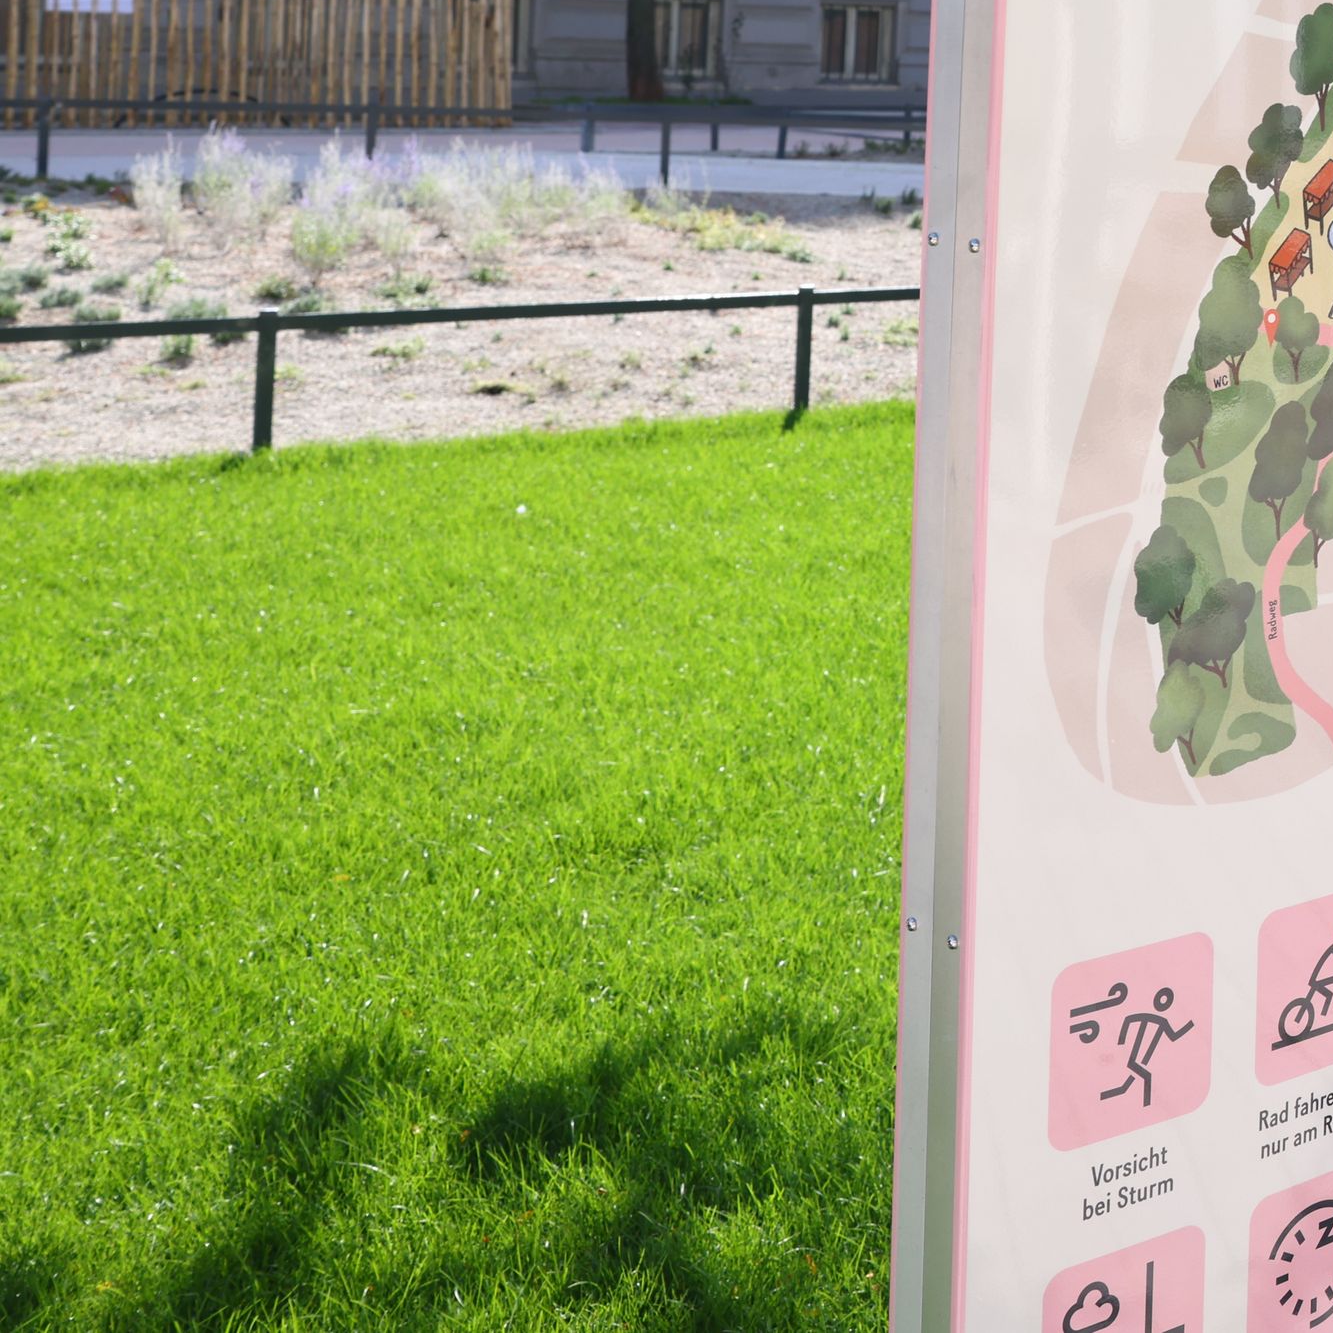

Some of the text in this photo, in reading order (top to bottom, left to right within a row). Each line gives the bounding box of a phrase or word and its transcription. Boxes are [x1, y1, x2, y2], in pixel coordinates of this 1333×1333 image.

[1213, 375, 1229, 389] WC
[1267, 600, 1278, 640] Radweg
[1258, 1101, 1289, 1132] Rad
[1260, 1136, 1289, 1159] nur
[1293, 1125, 1318, 1147] am
[1091, 1147, 1168, 1187] Vorsicht
[1082, 1177, 1175, 1221] bei Sturm
